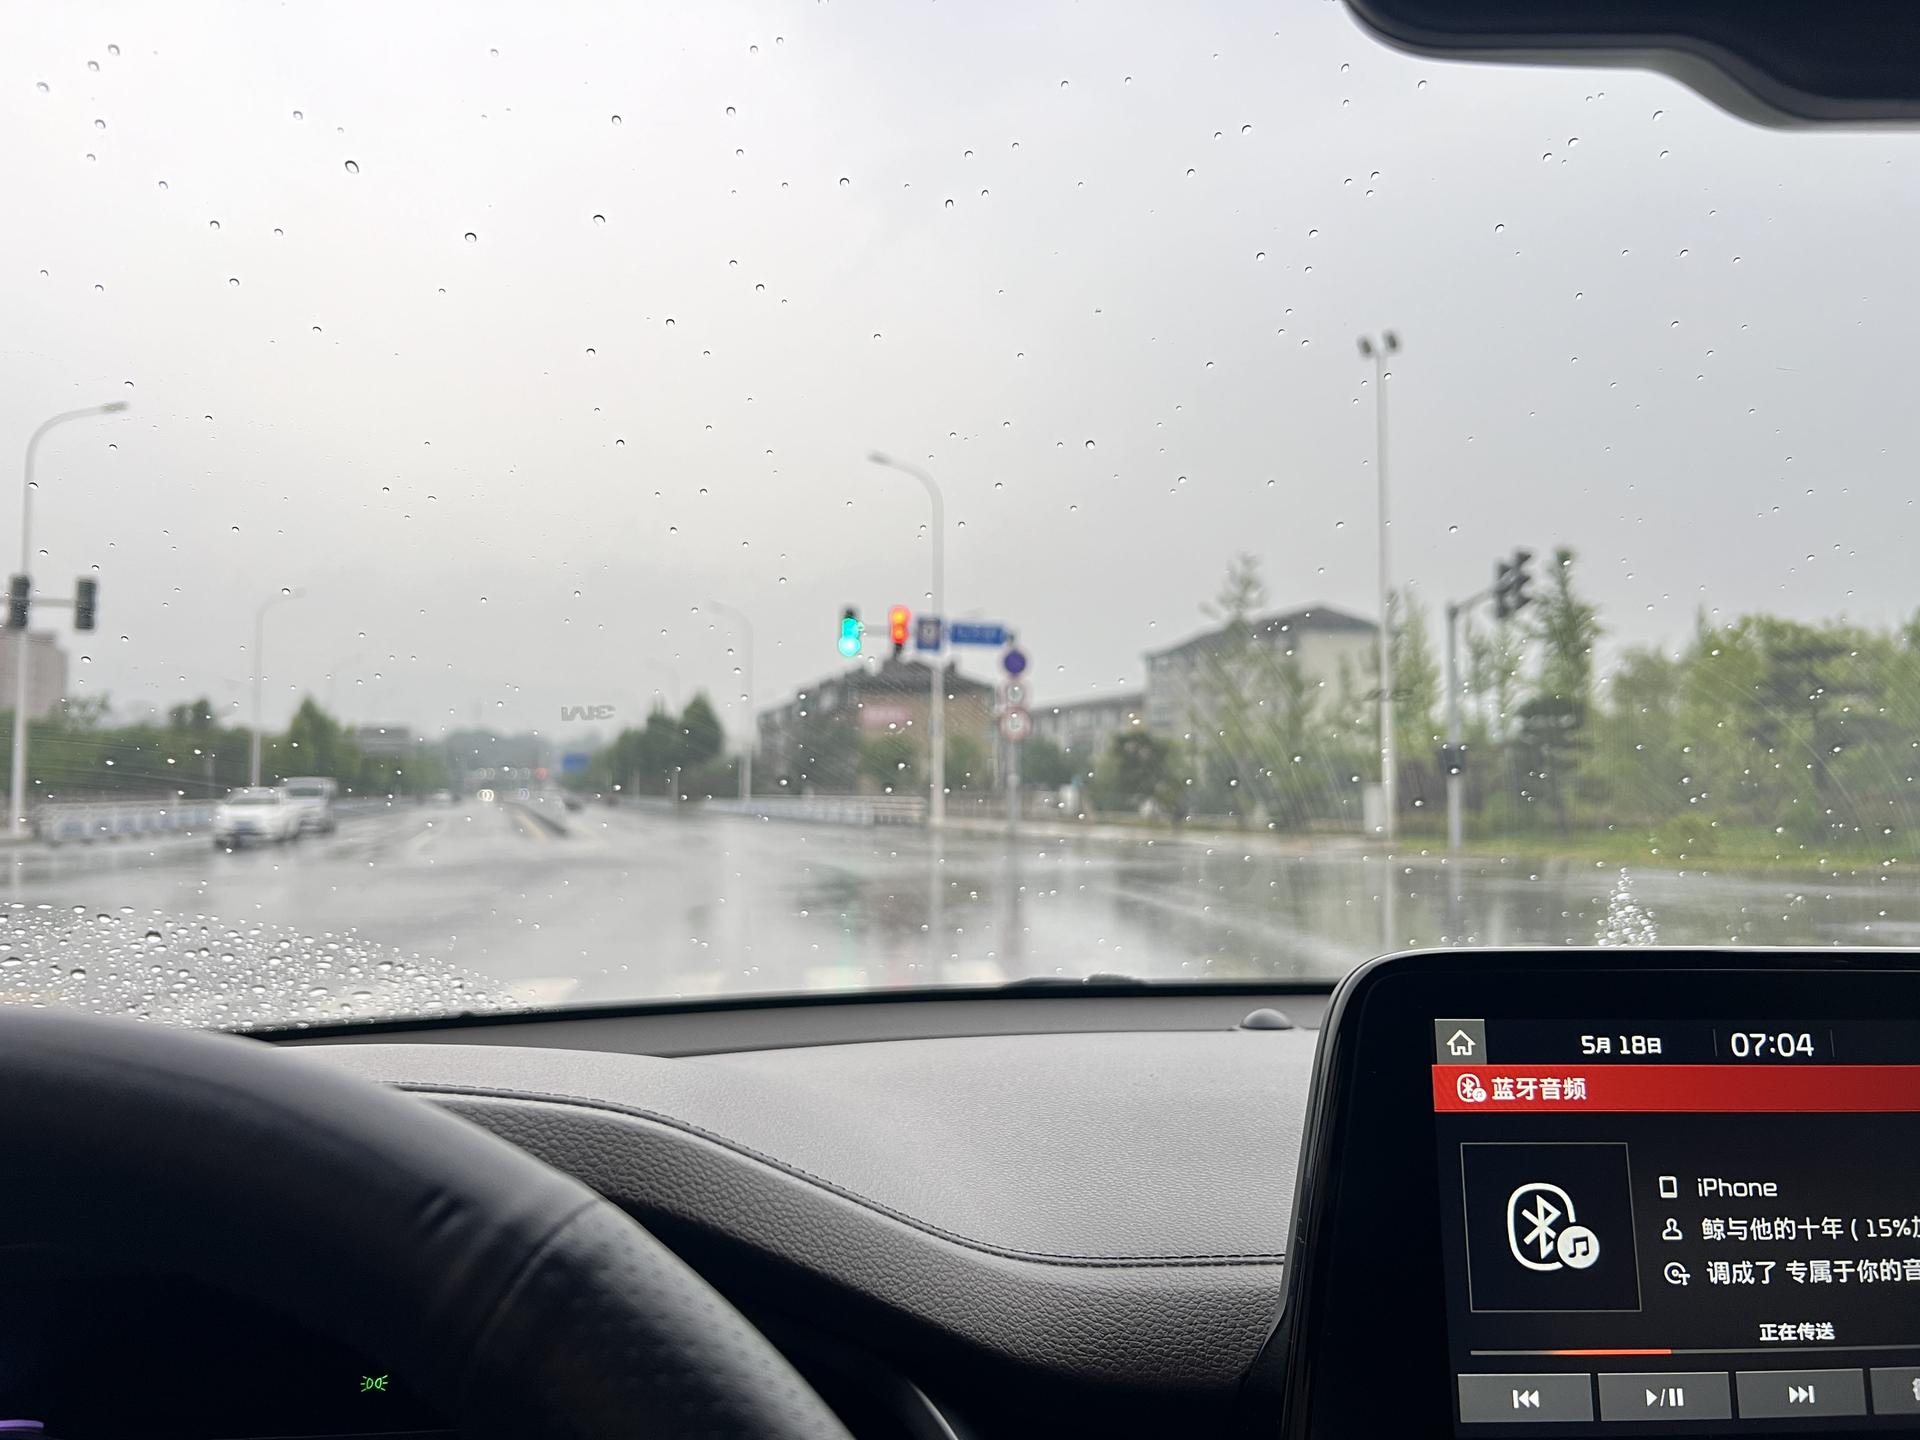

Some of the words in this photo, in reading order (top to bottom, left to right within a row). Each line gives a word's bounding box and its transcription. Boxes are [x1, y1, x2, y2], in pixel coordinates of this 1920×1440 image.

[1730, 1032, 1815, 1057] 07:04
[1491, 1077, 1587, 1101] 蓝牙音频
[1697, 1178, 1778, 1197] iPhone
[1759, 1322, 1835, 1342] 正在传送
